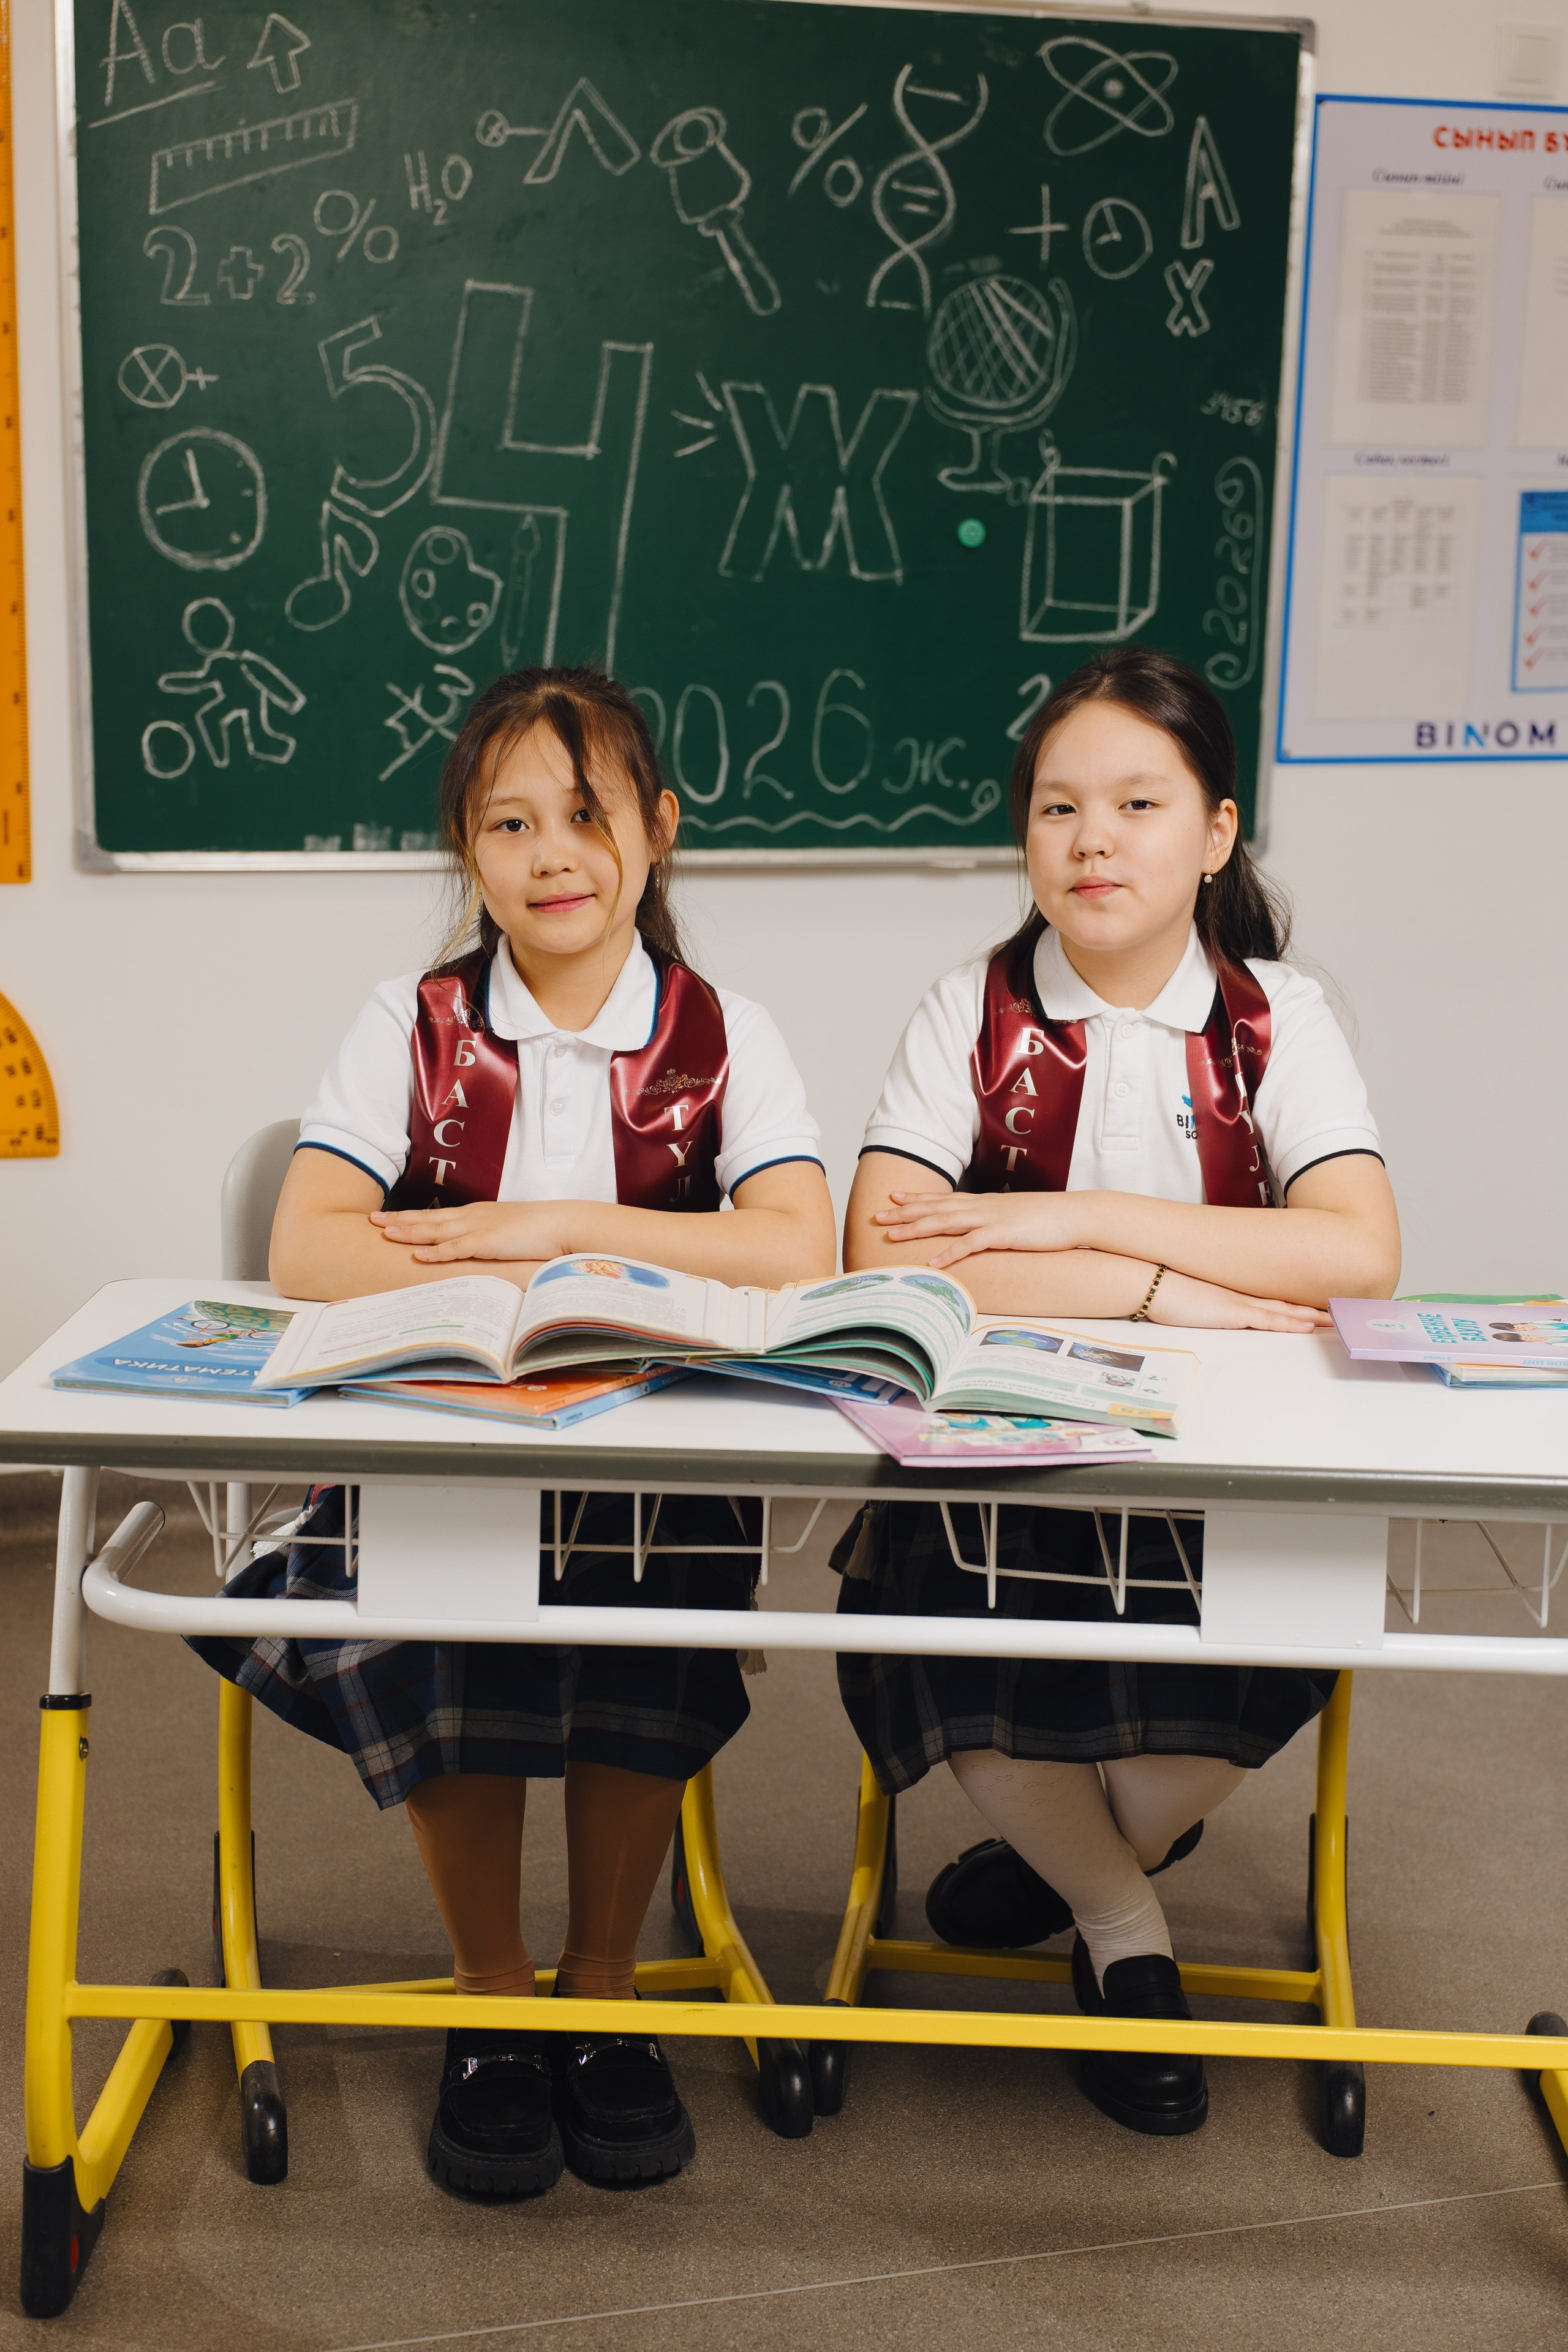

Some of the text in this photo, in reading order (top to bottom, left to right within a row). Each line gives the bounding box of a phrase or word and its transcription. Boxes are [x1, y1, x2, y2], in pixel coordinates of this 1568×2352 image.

[1433, 126, 1536, 153] СЫНЫП
[1415, 721, 1556, 750] BINOM
[1450, 1317, 1488, 1342] БАУЛУ
